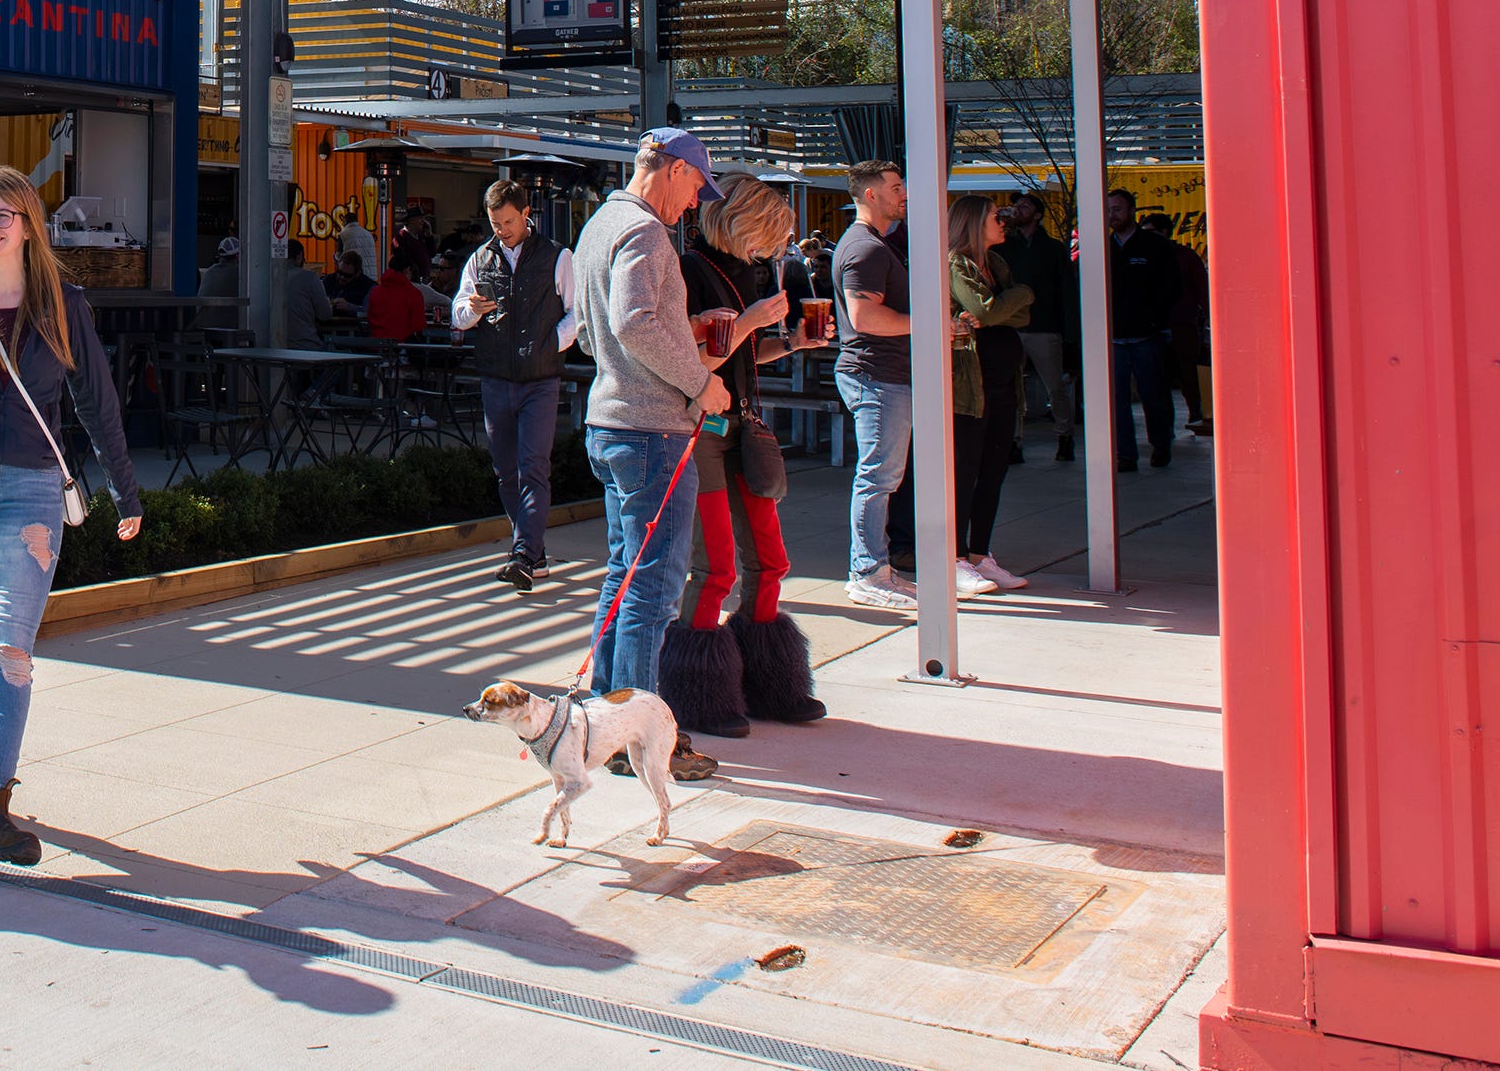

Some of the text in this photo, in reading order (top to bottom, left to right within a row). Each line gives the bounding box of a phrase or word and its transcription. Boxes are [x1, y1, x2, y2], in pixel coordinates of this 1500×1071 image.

[722, 3, 744, 13] PIZZA
[681, 20, 694, 29] KO
[696, 19, 726, 28] BURGER
[555, 27, 580, 37] GATHER
